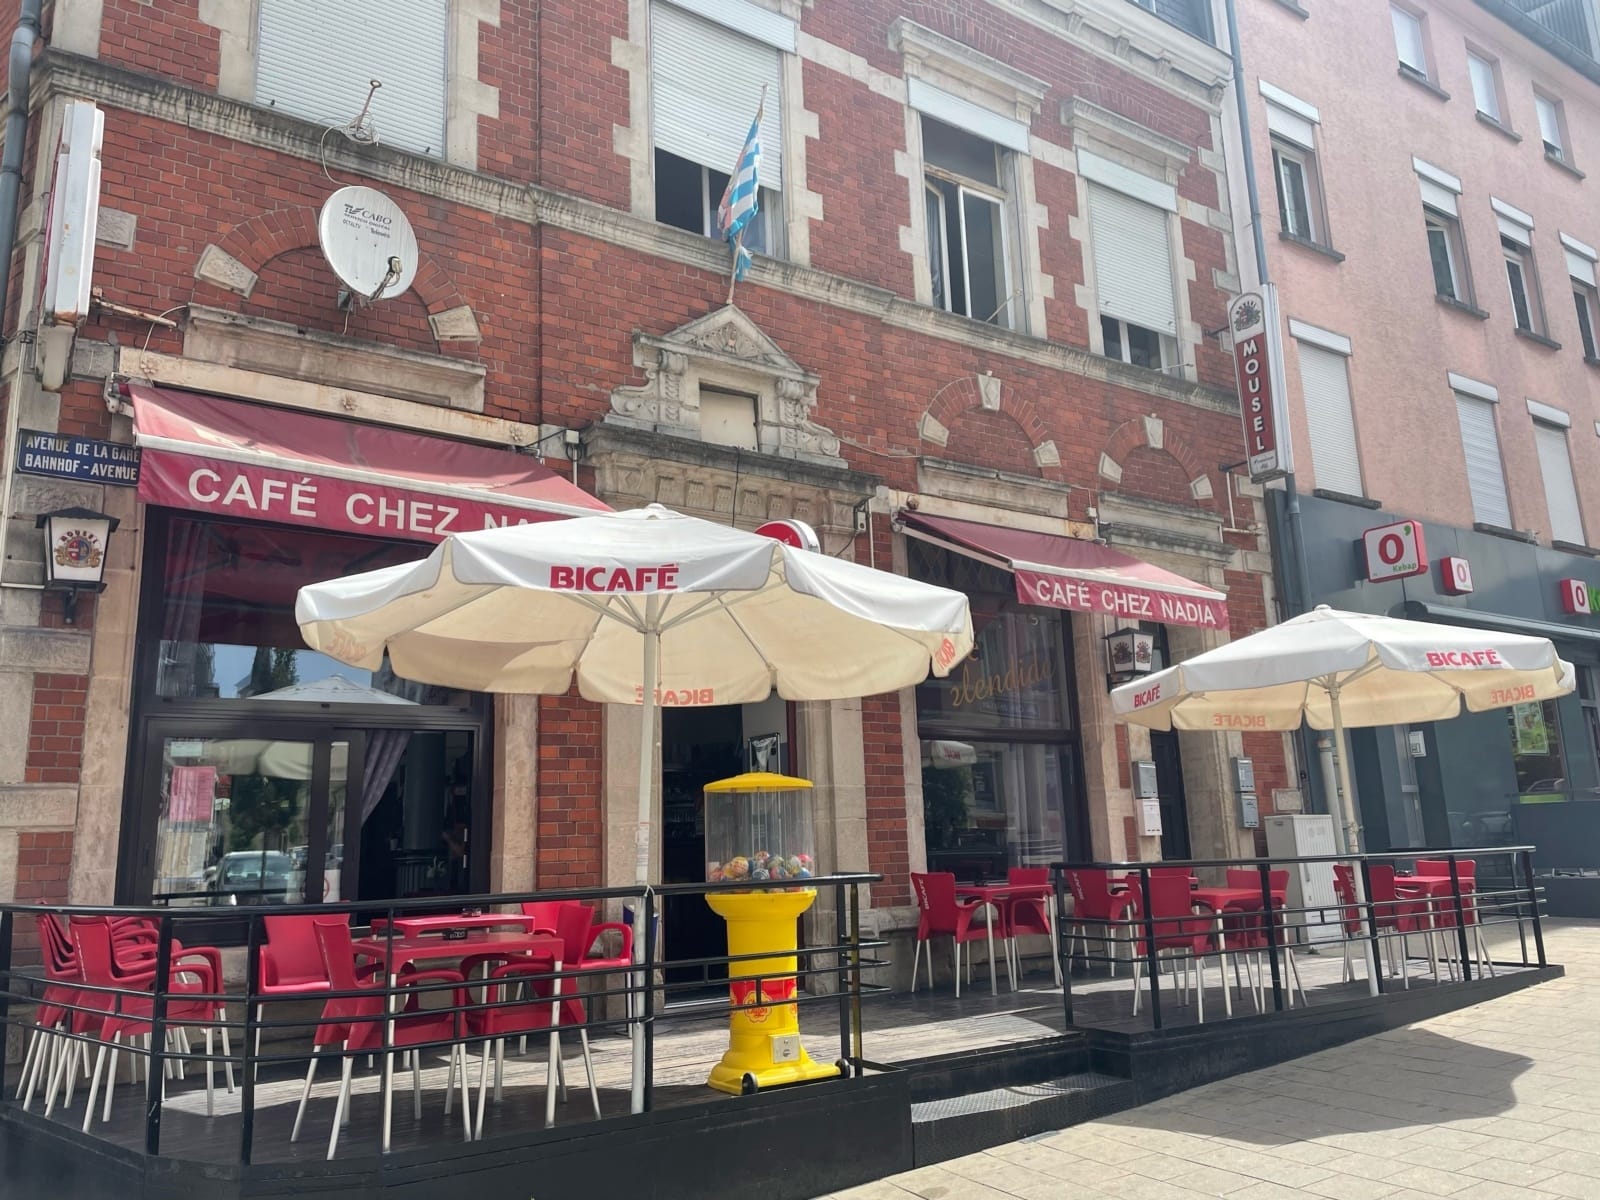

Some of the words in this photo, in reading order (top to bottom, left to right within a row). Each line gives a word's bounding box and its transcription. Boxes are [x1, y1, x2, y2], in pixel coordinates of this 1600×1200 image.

[361, 210, 392, 225] CABO
[1243, 339, 1265, 451] MOUSEL
[26, 436, 69, 453] AVENUE
[75, 442, 90, 456] DE
[94, 444, 108, 459] LA
[25, 453, 80, 473] BAHNHOF
[90, 462, 138, 481] AVENUE
[188, 468, 318, 518] CAFÉ
[345, 492, 460, 537] CHEZ
[550, 563, 679, 592] BICAFÉ
[1393, 562, 1417, 573] Kebap
[1036, 579, 1092, 608] CAFÉ
[1101, 589, 1153, 616] CHEZ
[1160, 598, 1217, 625] NADIA
[1426, 648, 1502, 667] BICAFÉ
[1133, 683, 1161, 708] BICAFÉ
